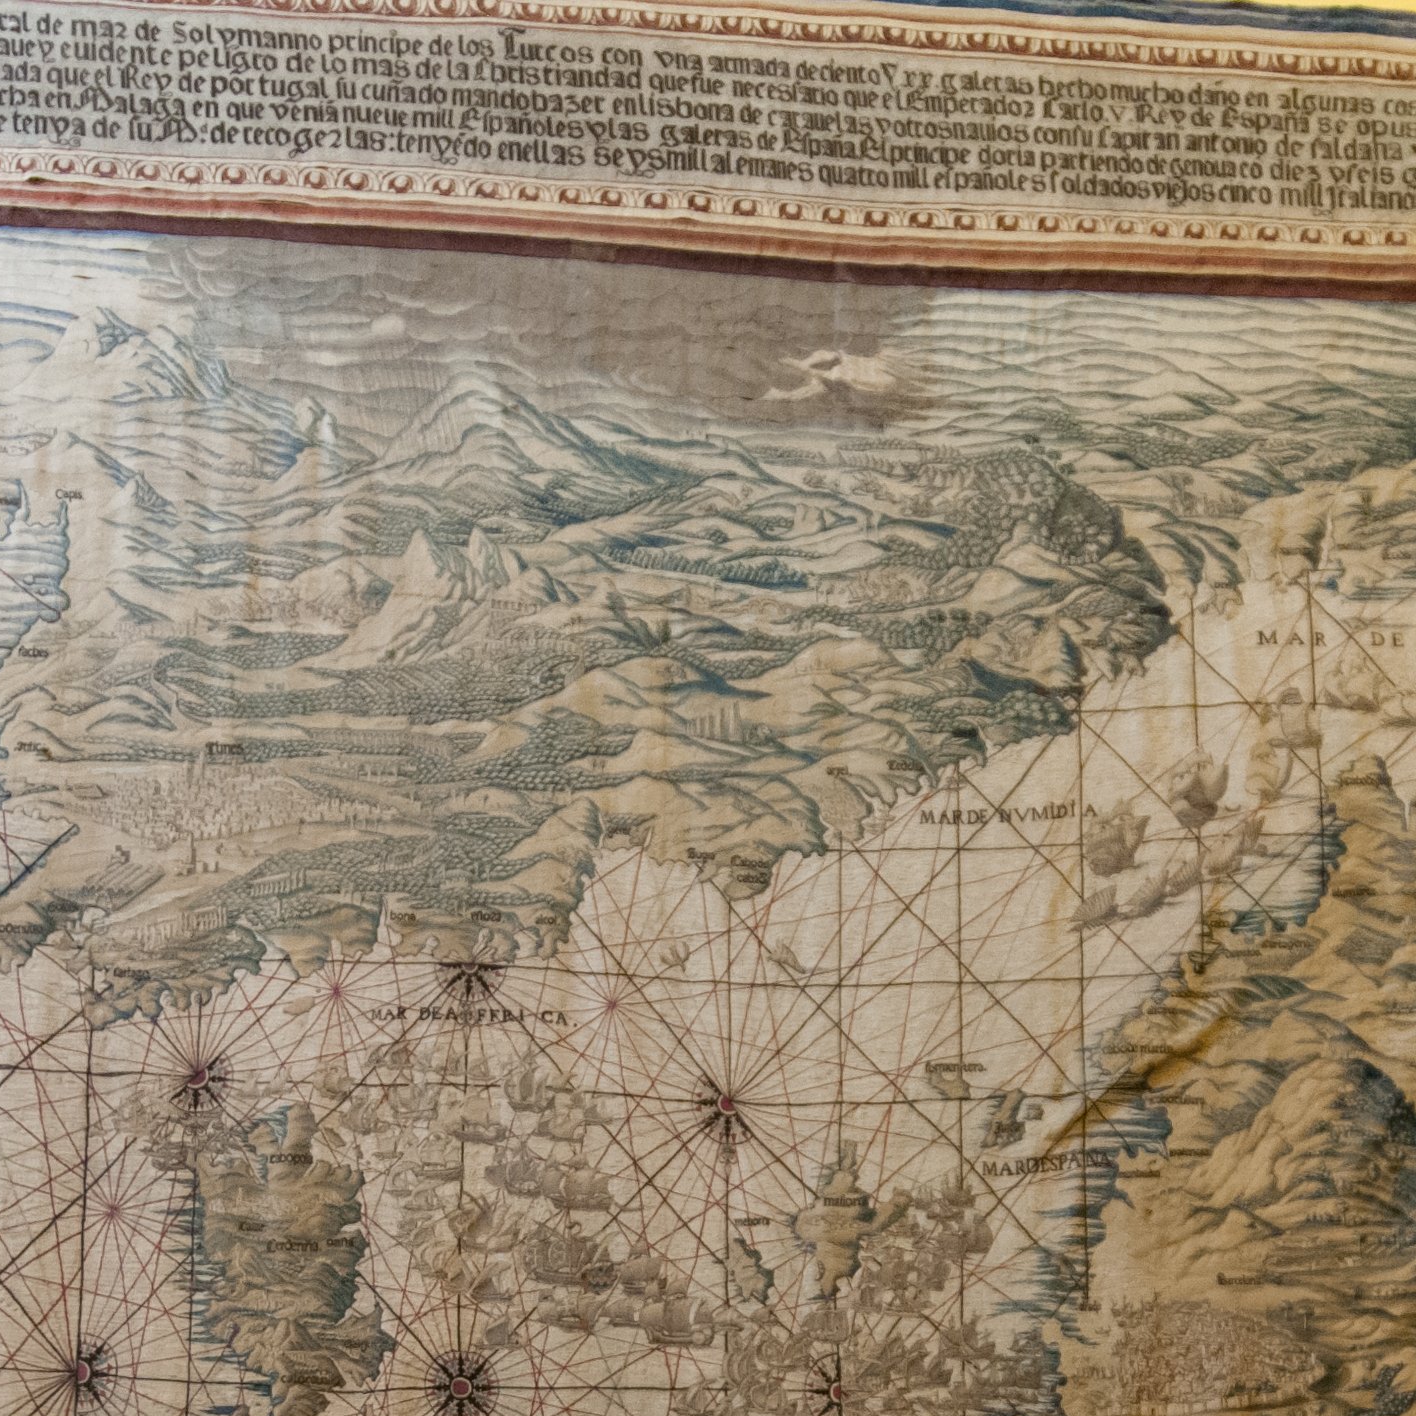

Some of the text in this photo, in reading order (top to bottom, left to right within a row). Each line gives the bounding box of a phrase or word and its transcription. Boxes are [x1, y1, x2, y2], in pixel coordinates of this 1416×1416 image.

[37, 12, 63, 36] de
[135, 18, 161, 42] de
[429, 33, 453, 56] de
[602, 48, 642, 67] con
[285, 49, 314, 73] de
[416, 55, 443, 79] de
[448, 57, 470, 80] la
[193, 101, 219, 119] en
[1370, 630, 1404, 648] DE
